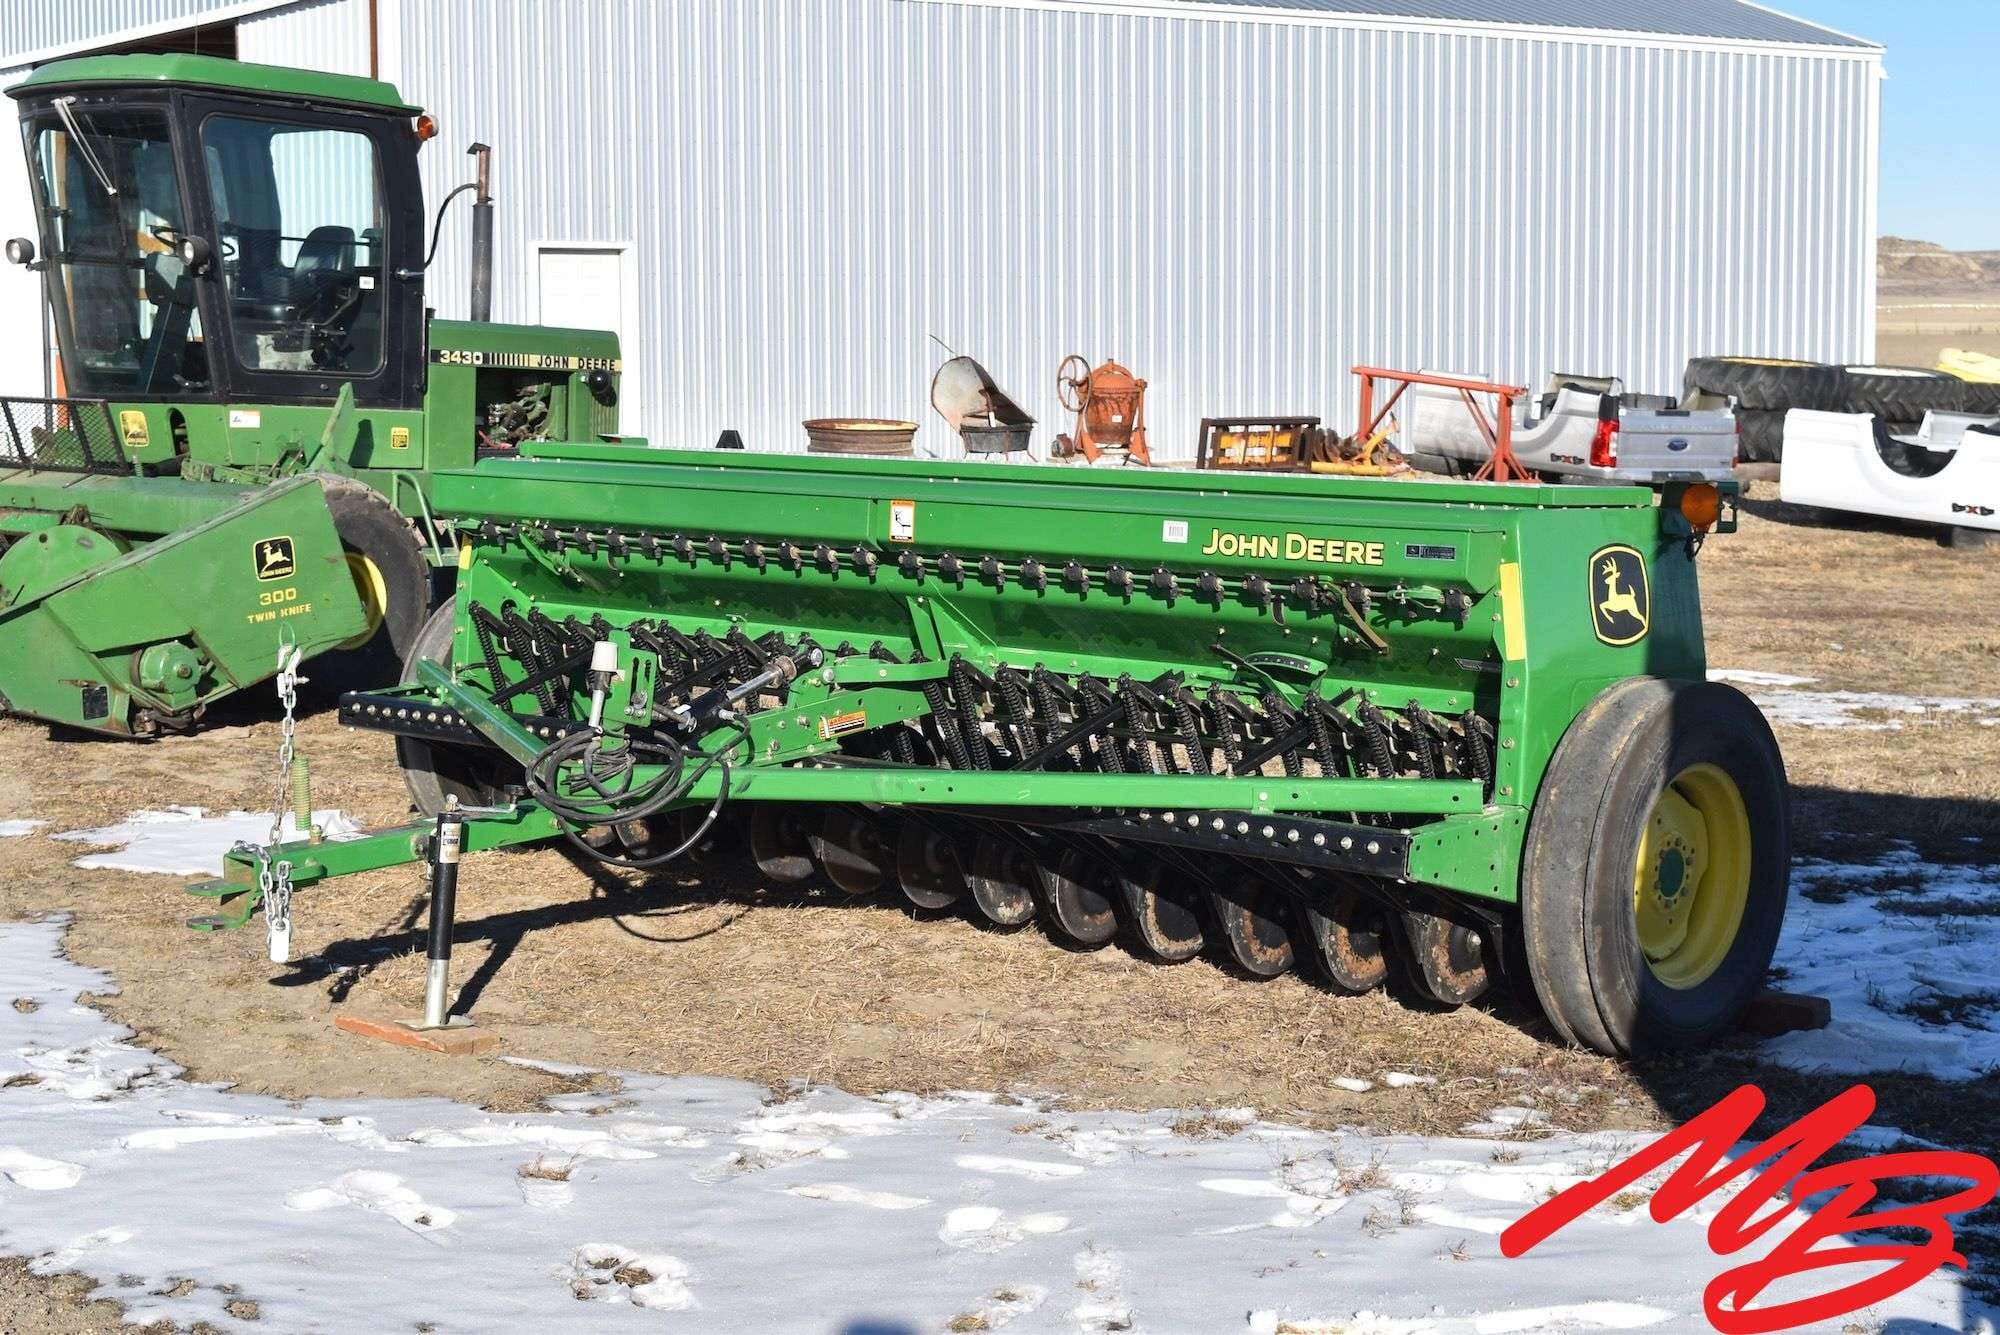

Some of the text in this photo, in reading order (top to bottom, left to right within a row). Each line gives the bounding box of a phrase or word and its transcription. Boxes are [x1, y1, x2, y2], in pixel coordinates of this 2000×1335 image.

[440, 350, 616, 370] 3430 JOHN DEERE
[1202, 528, 1385, 566] JOHN DEERE
[260, 587, 297, 606] 300
[248, 603, 312, 624] TWIN KNIFE
